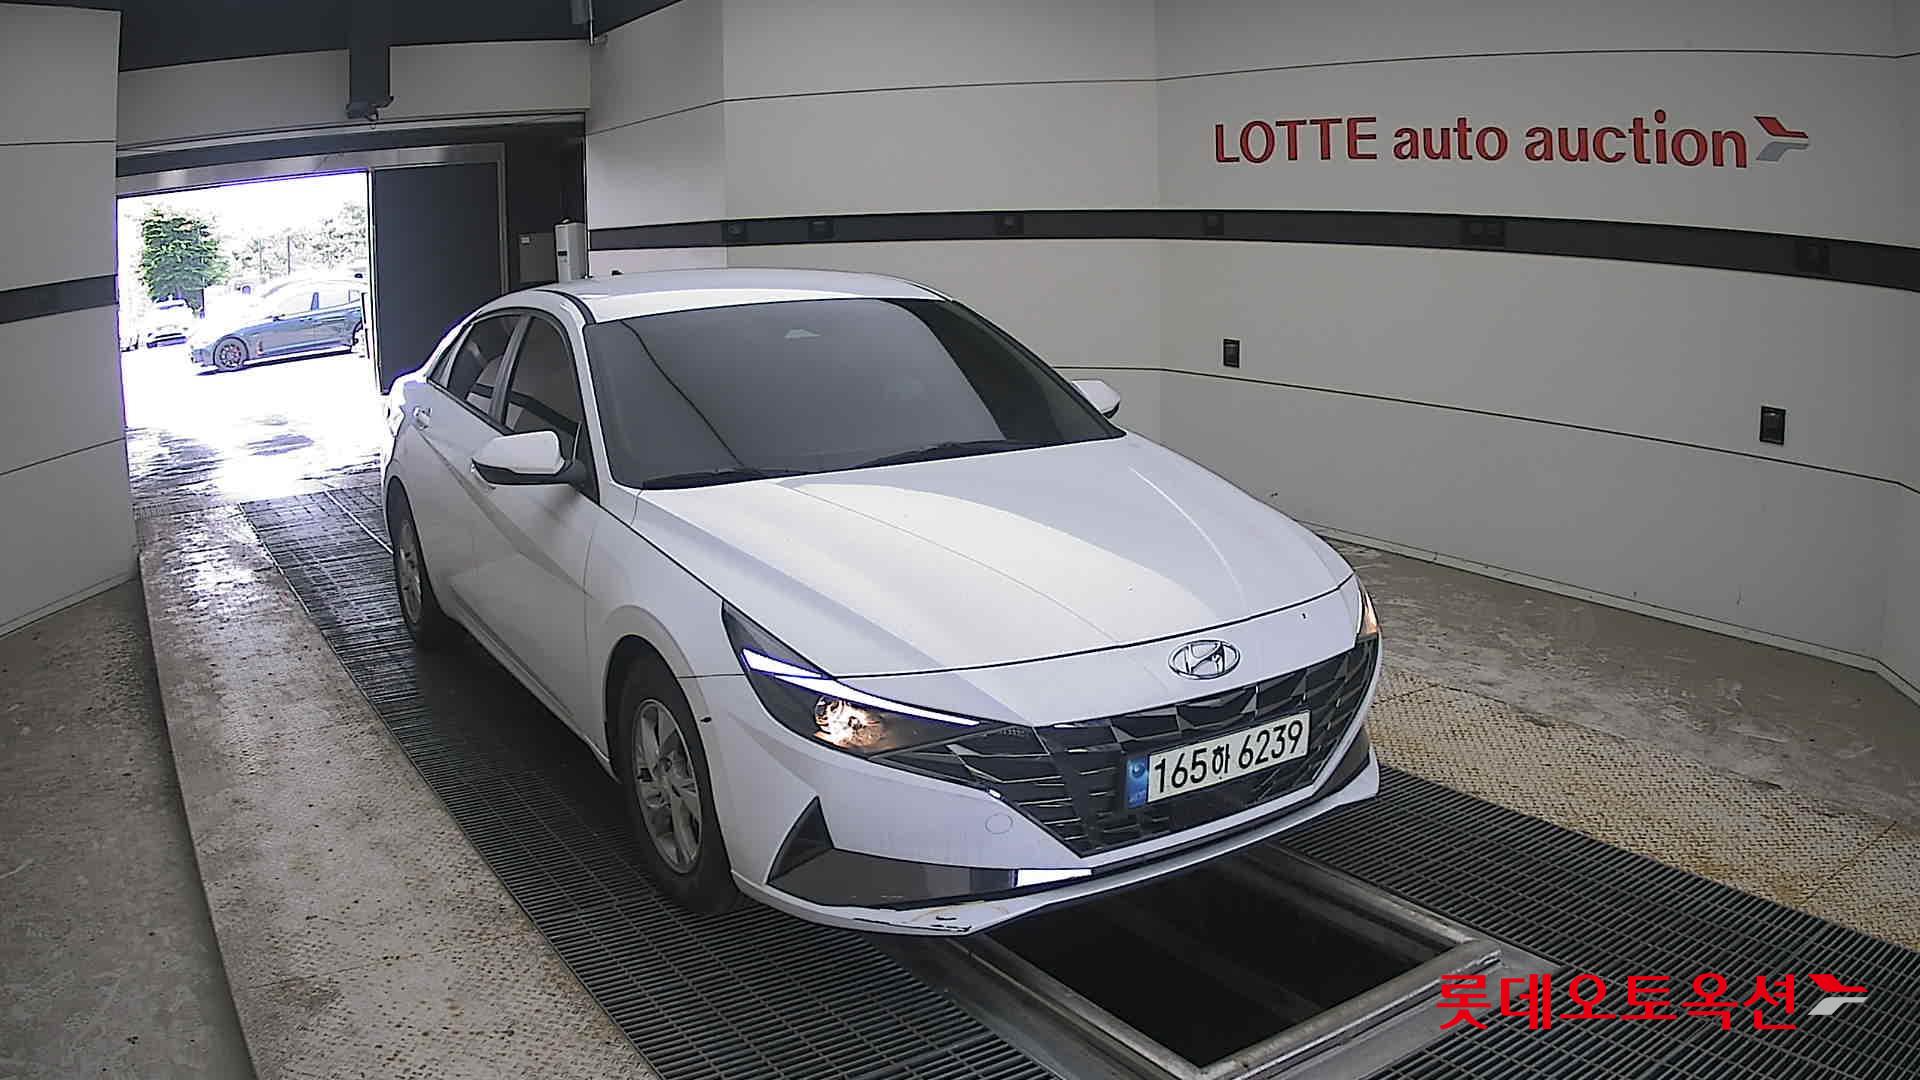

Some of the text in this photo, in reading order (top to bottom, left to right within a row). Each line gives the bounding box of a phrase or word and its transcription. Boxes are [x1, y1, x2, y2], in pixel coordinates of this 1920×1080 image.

[1214, 109, 1748, 168] LOTTE auto auction
[1154, 720, 1303, 793] 165하 6239
